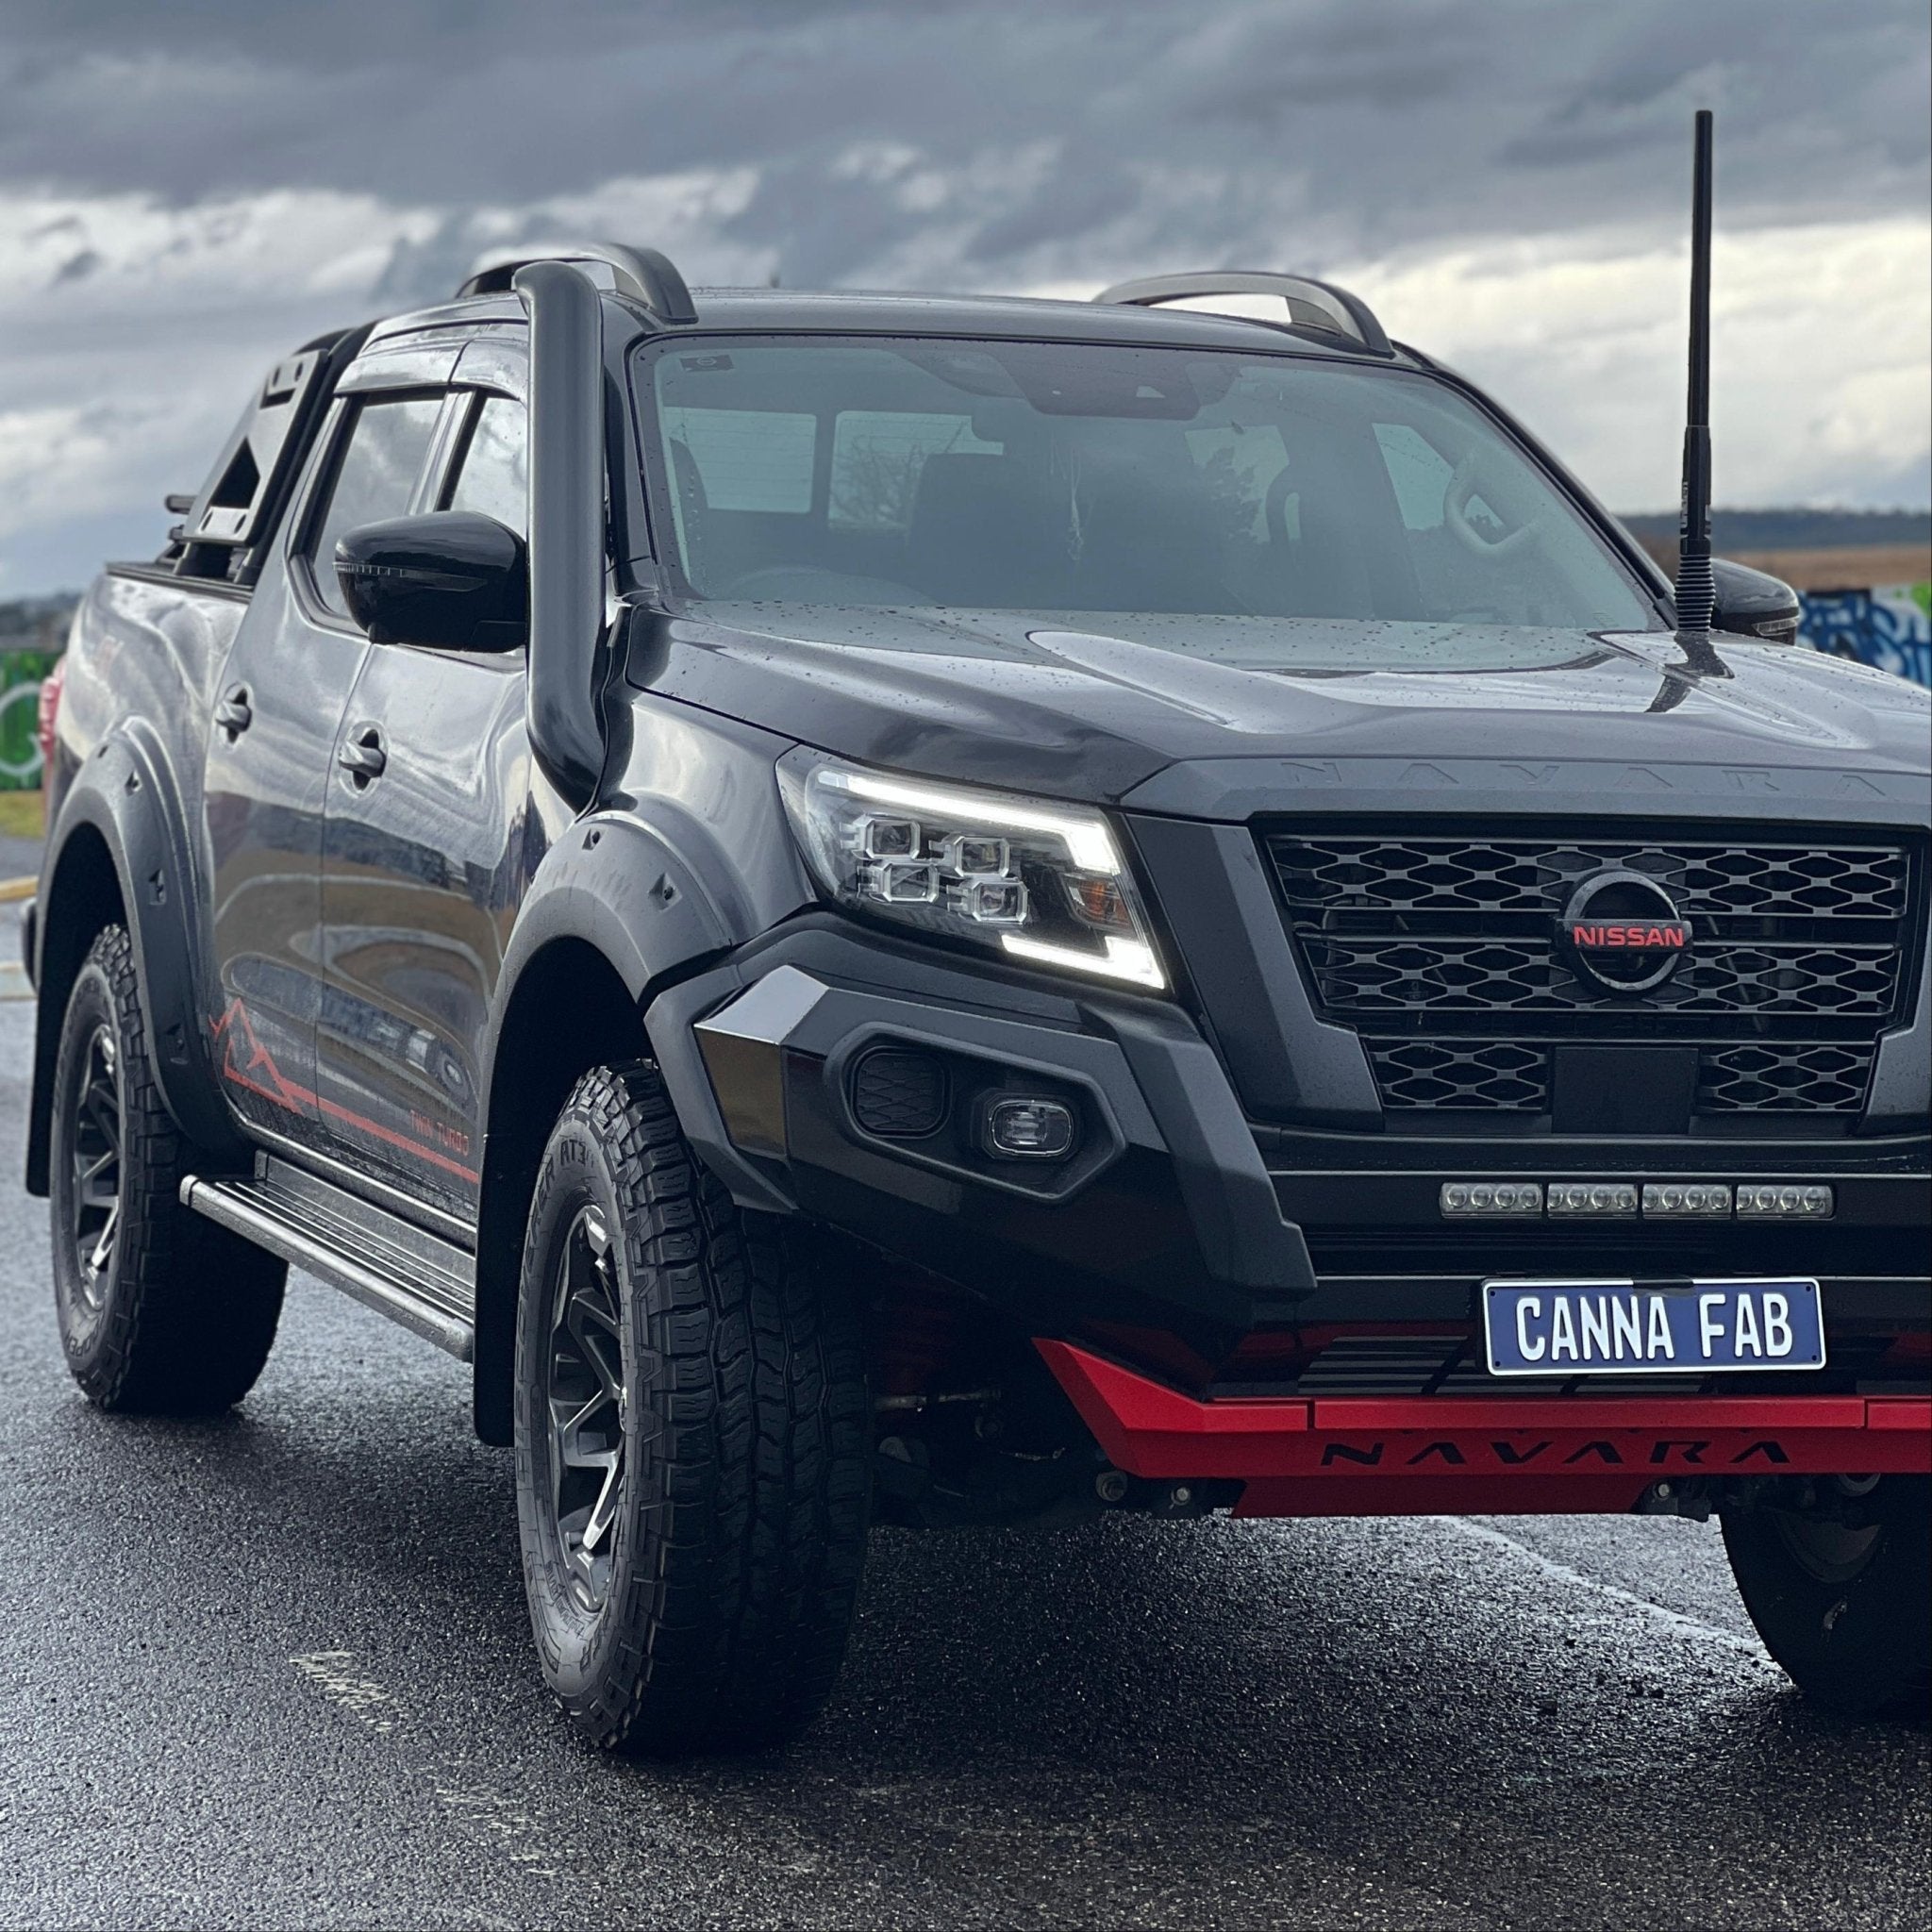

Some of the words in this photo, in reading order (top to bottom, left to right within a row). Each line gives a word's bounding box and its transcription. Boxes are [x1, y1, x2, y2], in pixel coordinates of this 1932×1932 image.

[1279, 761, 1887, 796] NAVARA
[1574, 926, 1684, 946] NISSAN
[1516, 1296, 1675, 1361] CANNA
[1699, 1292, 1793, 1358] FAB
[1321, 1441, 1791, 1466] NAVARA
